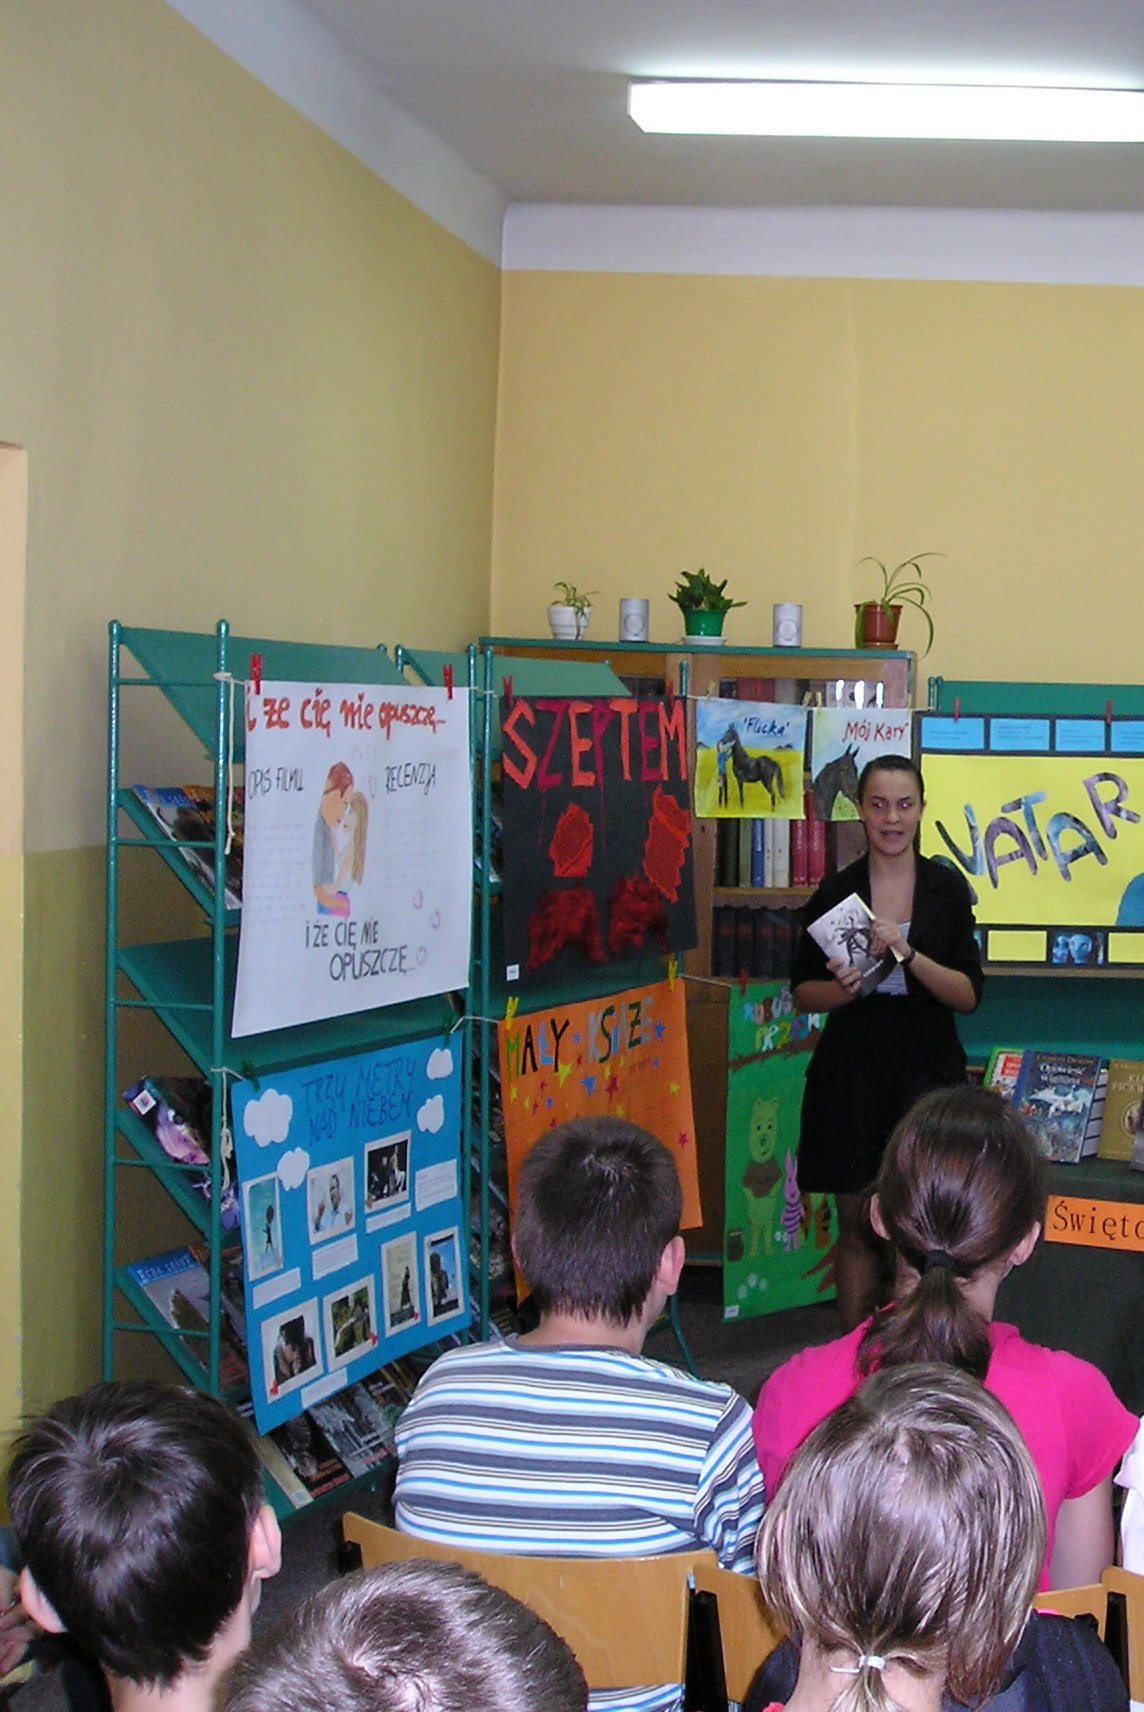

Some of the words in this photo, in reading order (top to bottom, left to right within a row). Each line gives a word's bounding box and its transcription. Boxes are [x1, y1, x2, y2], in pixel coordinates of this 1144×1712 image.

[339, 692, 375, 730] nie
[502, 698, 688, 790] SZEPTEM
[385, 762, 437, 796] RECENZJA
[335, 920, 357, 950] CIĘ
[505, 1018, 570, 1083] MAŁY
[309, 1108, 337, 1146] NAD
